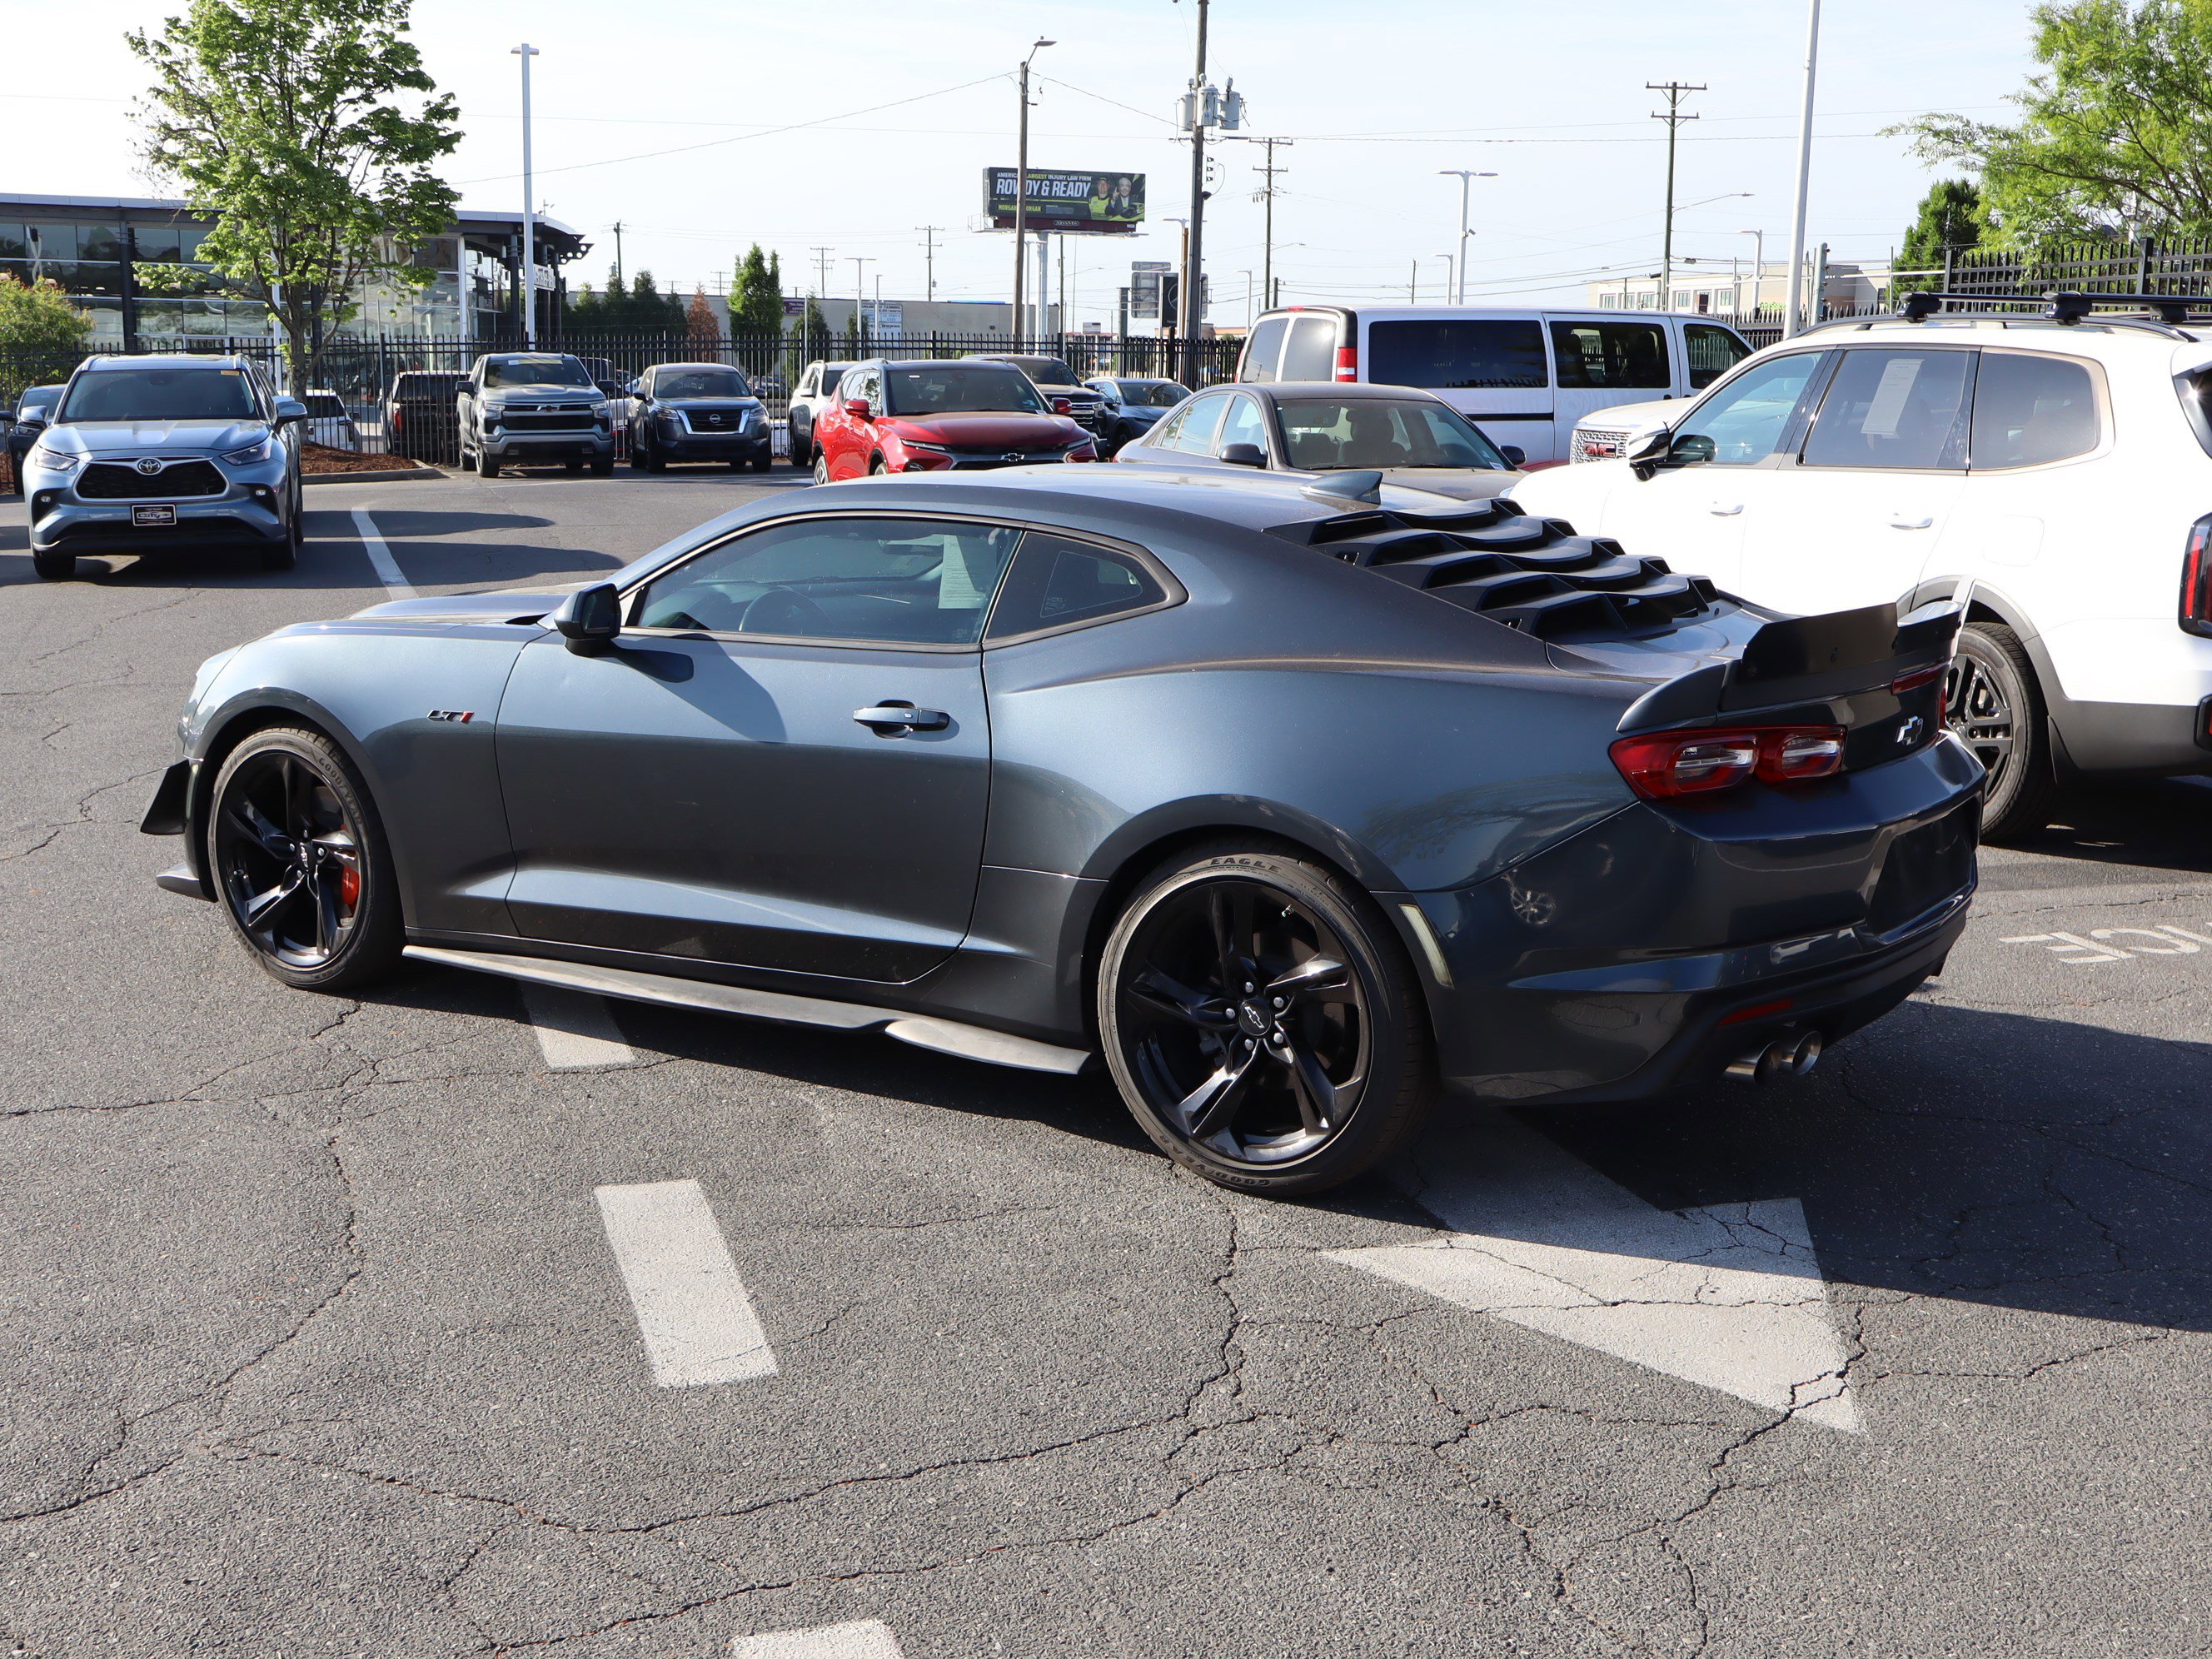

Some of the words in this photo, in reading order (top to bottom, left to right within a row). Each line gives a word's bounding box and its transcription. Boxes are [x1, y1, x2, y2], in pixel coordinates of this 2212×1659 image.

[1041, 180, 1050, 196] &
[1052, 181, 1091, 197] READY
[1582, 442, 1615, 457] GMC
[426, 710, 475, 725] LT1
[1210, 856, 1283, 874] EAGLE
[1158, 1134, 1272, 1187] GOODYEAR
